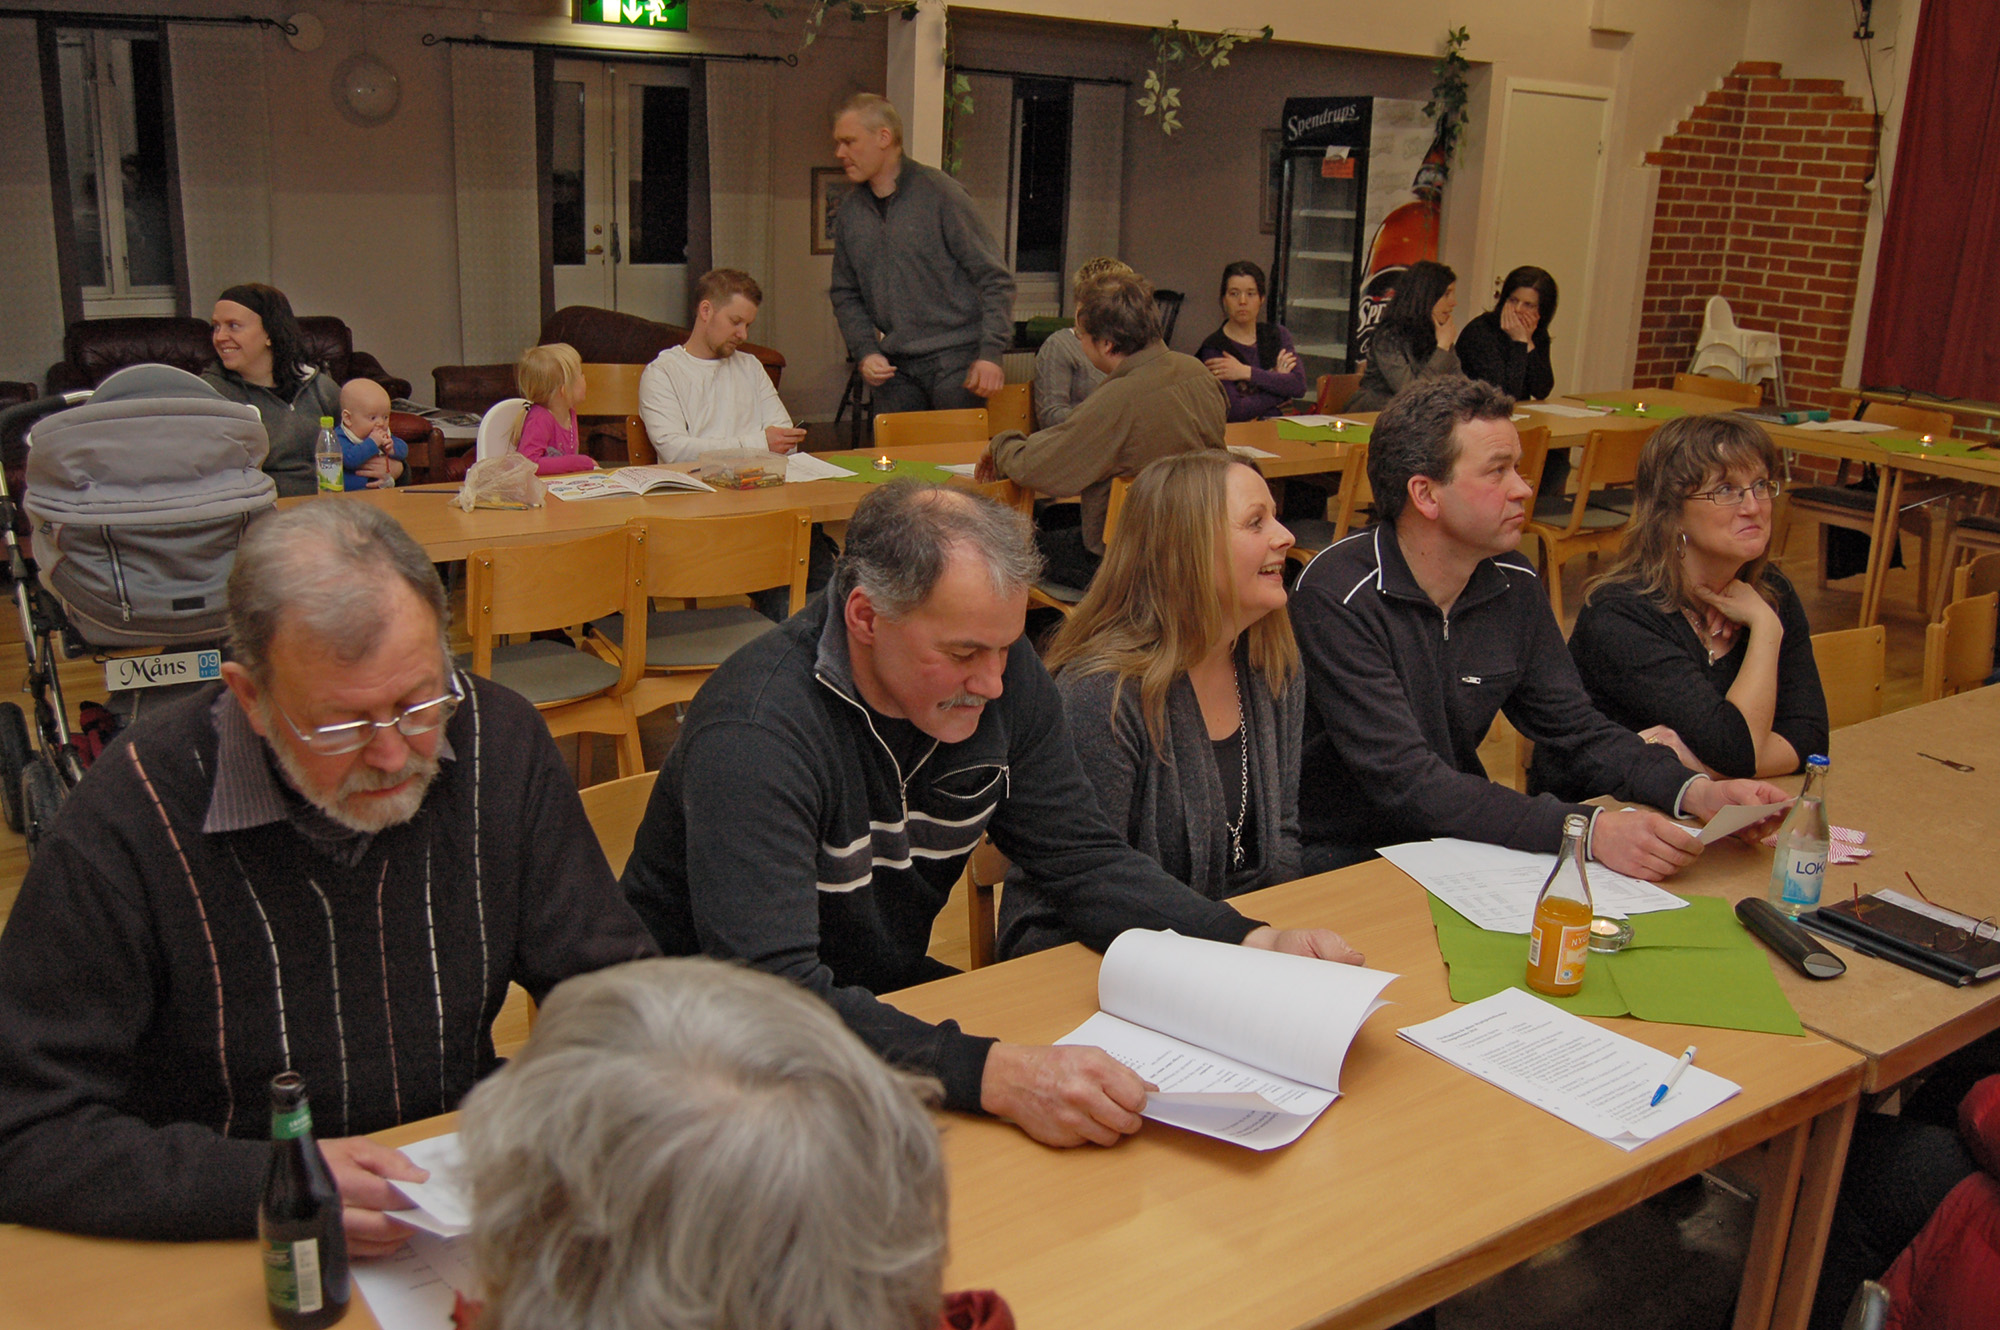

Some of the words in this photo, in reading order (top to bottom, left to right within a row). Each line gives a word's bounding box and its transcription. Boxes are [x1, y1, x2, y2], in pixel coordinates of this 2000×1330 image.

[1288, 104, 1358, 141] Spendrups
[199, 654, 218, 668] 09
[120, 658, 187, 686] Måns
[1796, 861, 1826, 875] LOK
